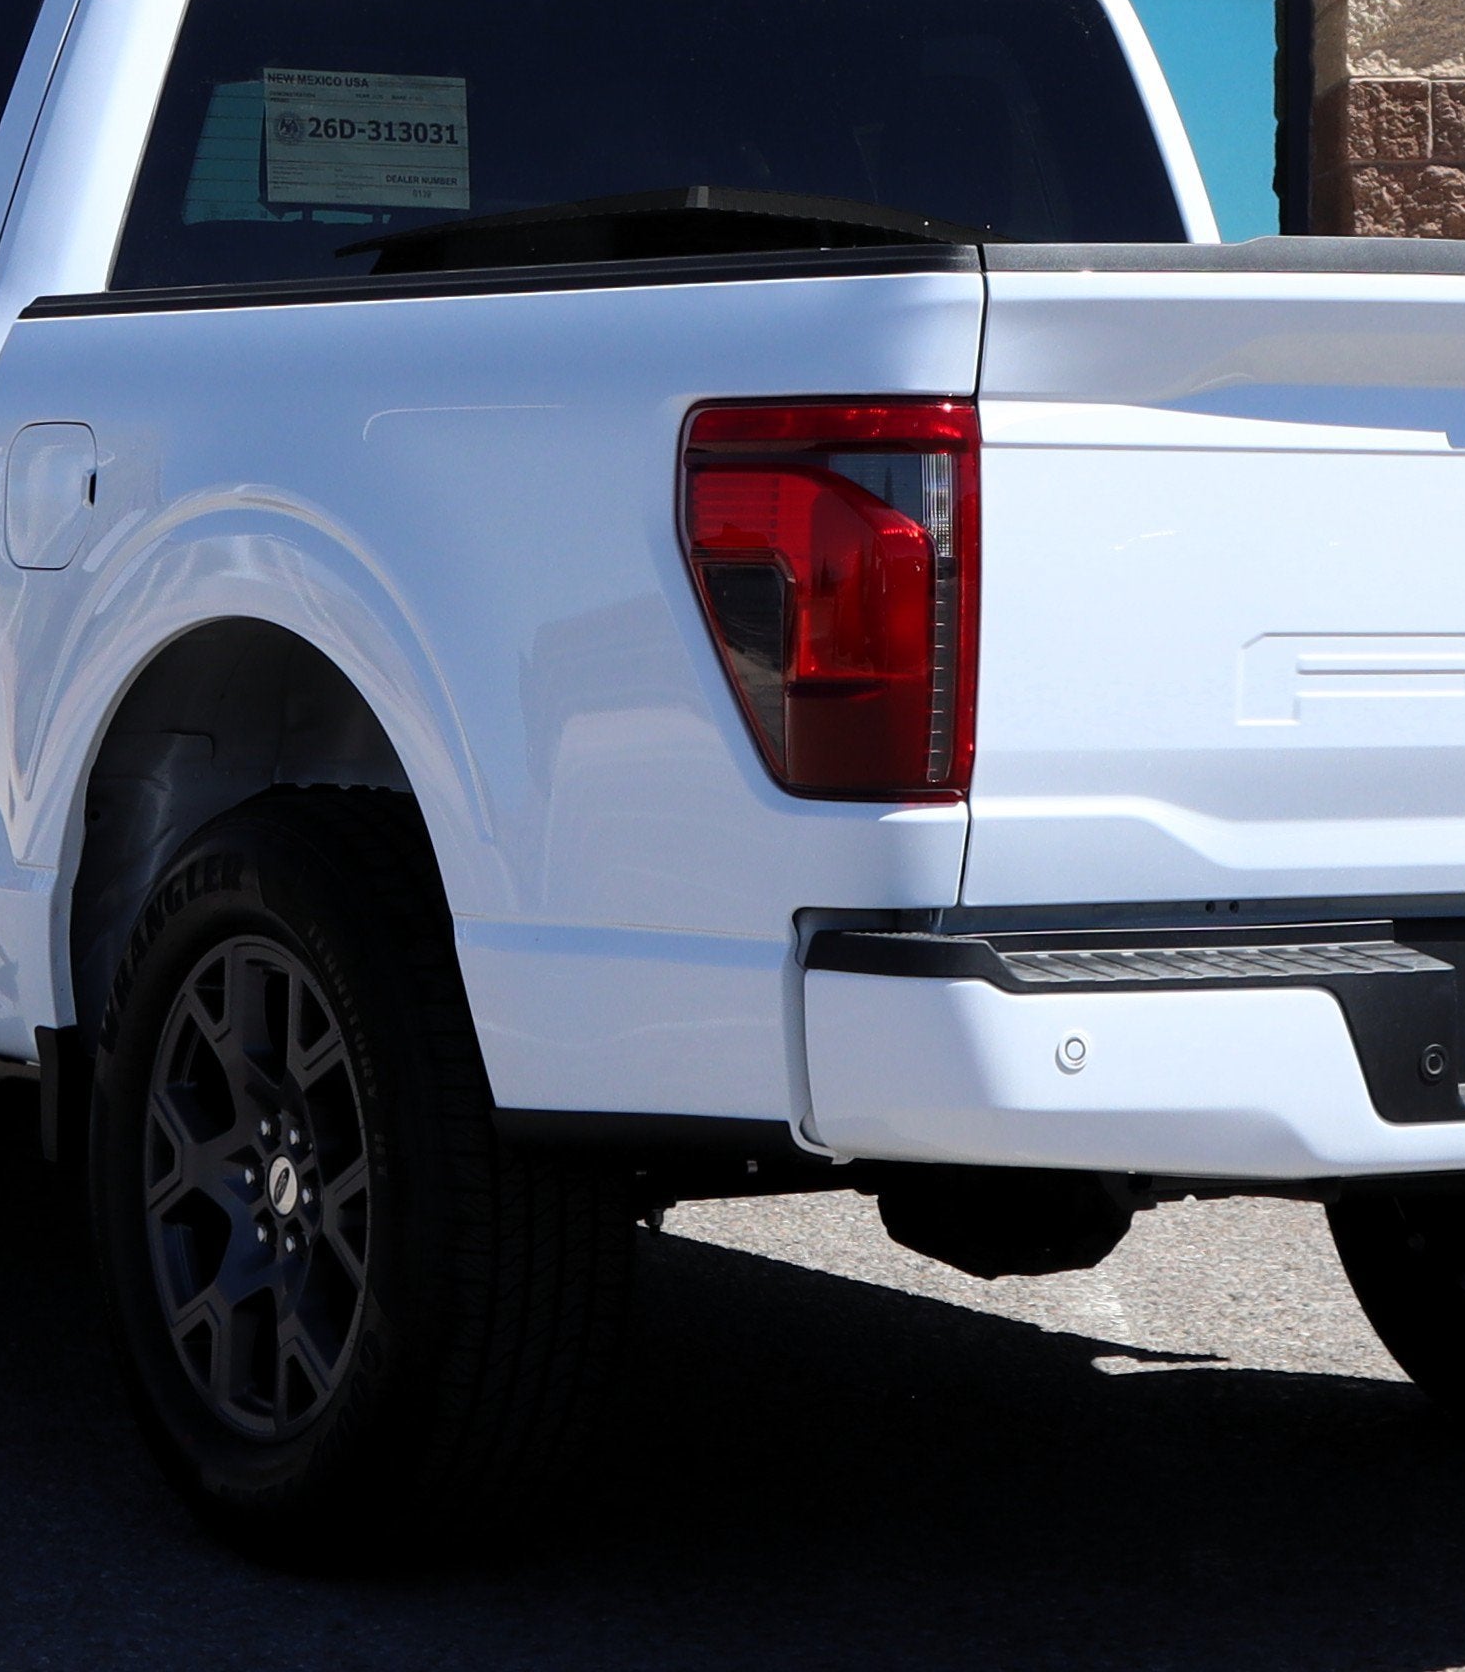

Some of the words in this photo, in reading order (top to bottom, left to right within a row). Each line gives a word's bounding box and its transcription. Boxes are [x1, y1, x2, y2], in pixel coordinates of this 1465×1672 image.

[267, 73, 295, 85] NEW
[297, 74, 342, 87] MEXICO
[345, 76, 370, 89] USA
[308, 117, 459, 145] 26D-313031
[385, 174, 419, 184] DEALER
[421, 176, 458, 186] NUMBER
[98, 850, 246, 1055] WRANGLER
